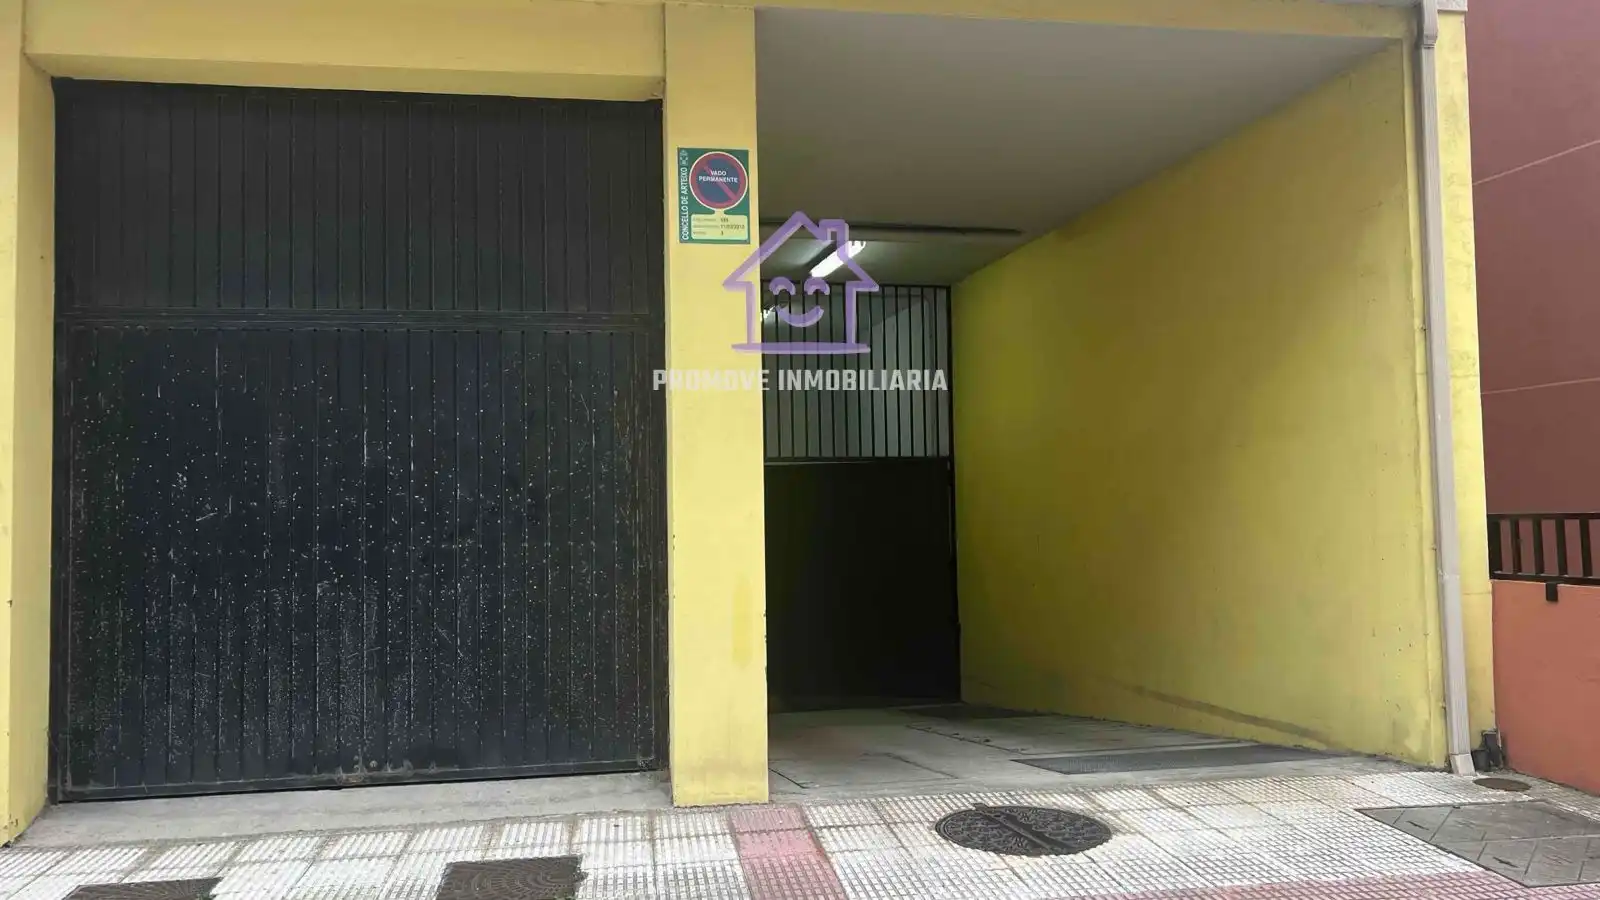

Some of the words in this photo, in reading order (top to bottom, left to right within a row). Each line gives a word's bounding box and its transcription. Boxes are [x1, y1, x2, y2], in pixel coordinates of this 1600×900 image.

[680, 167, 688, 195] ARTEIXO
[698, 175, 738, 183] PERMANENTE
[681, 195, 689, 205] DE
[681, 205, 689, 241] CONCELLO
